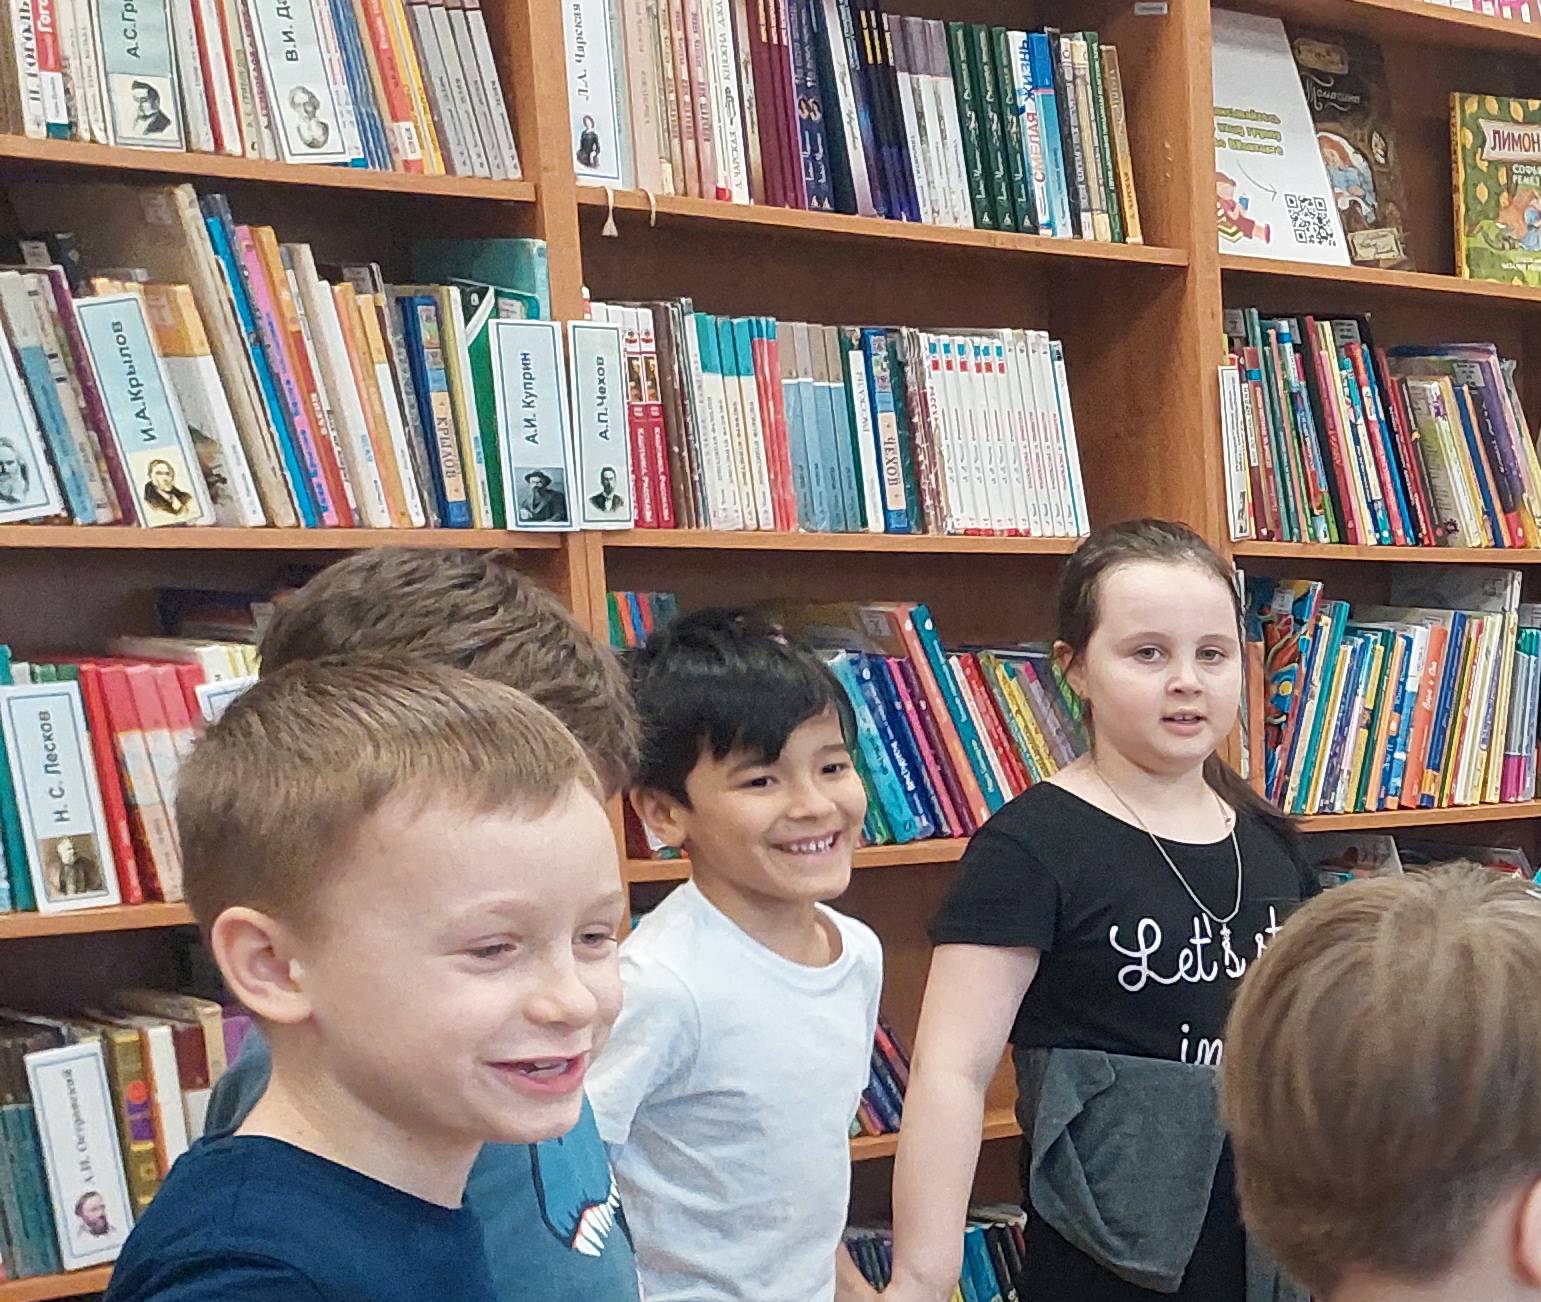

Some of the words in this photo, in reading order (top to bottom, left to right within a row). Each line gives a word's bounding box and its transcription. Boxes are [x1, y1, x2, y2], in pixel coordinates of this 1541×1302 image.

[122, 0, 140, 58] А.С.Гр
[1018, 39, 1036, 103] ЖИЗНЬ
[1023, 112, 1046, 184] СМЕЛАЯ
[111, 320, 157, 442] И.А.Крылов
[519, 352, 539, 408] Куприн
[594, 355, 611, 442] А.П.Чехов
[436, 415, 458, 479] КРЫЛОВ
[882, 435, 901, 488] ЧЕХОВ
[38, 710, 62, 775] Лесков
[1108, 912, 1247, 992] Let's
